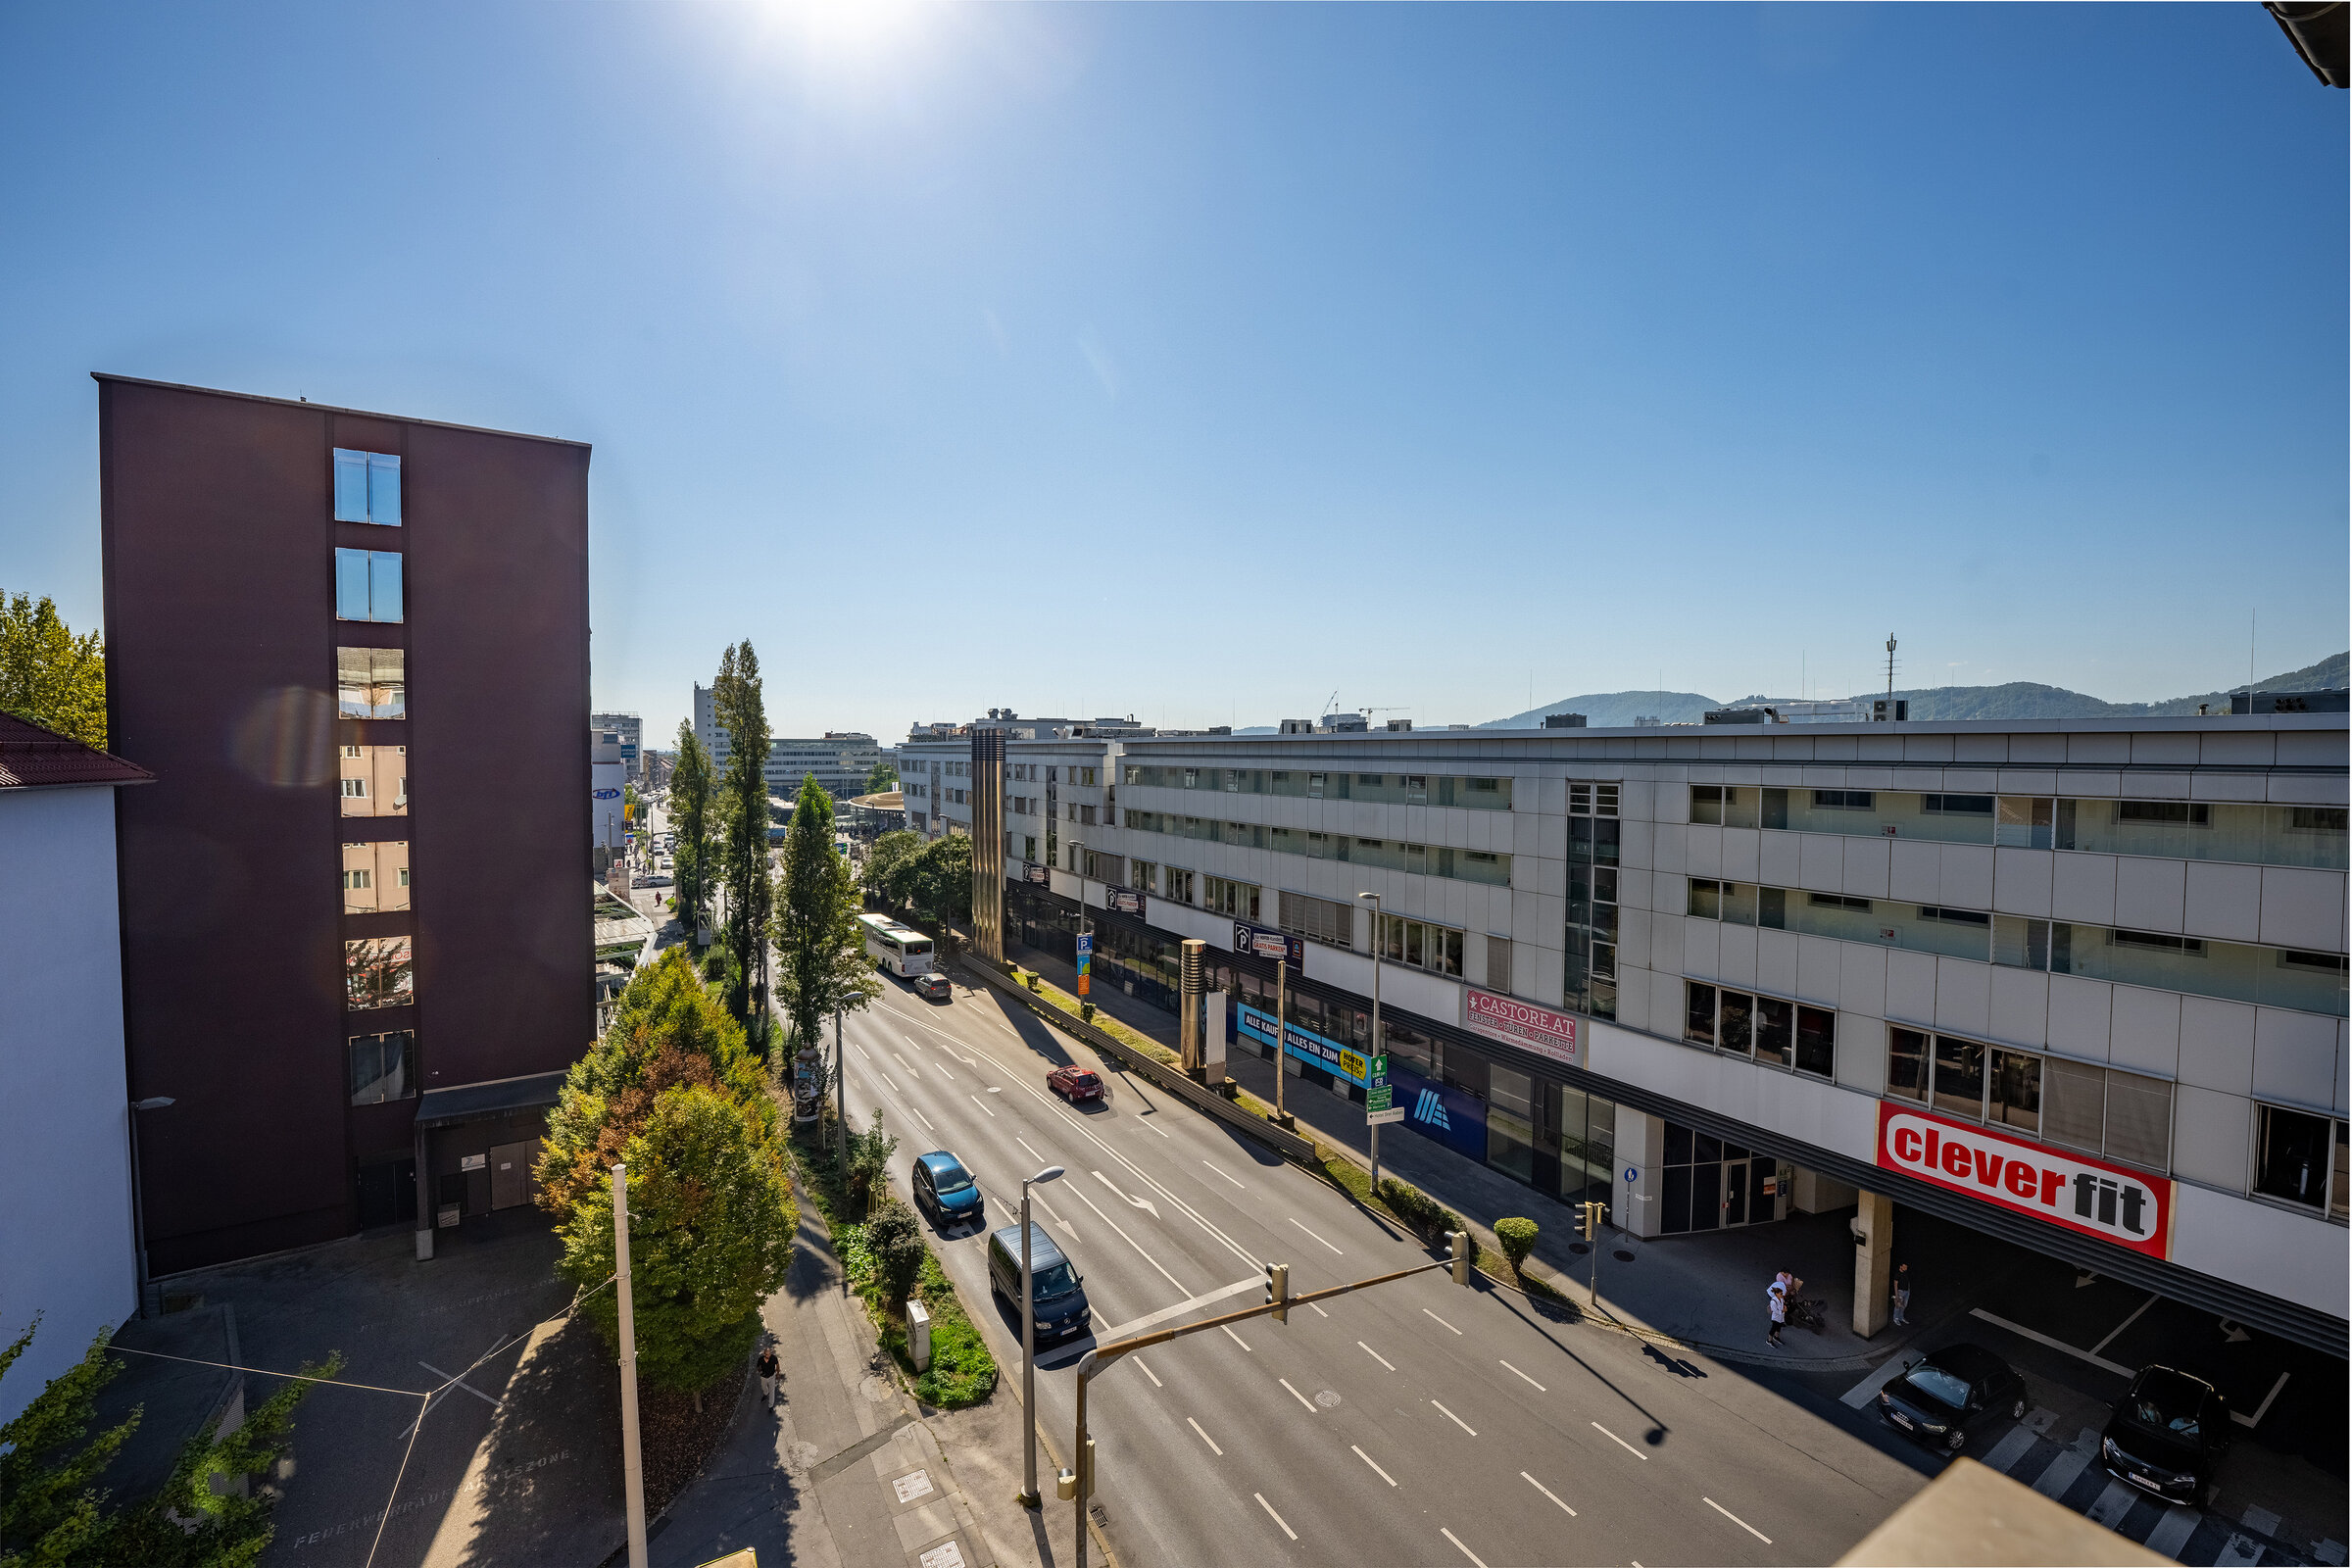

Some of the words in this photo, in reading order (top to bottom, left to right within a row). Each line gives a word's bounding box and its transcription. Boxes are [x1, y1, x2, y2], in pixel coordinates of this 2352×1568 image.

[1109, 895, 1115, 906] P
[1080, 940, 1088, 950] P
[1240, 934, 1247, 949] P
[1253, 941, 1267, 950] GRATIS
[1480, 996, 1574, 1036] CASTORE.AT
[1246, 1014, 1260, 1029] ALLE
[1261, 1020, 1287, 1041] KAUF
[1287, 1033, 1308, 1050] ALLES
[1308, 1041, 1321, 1055] EIN
[1322, 1047, 1339, 1063] ZUM
[1469, 1010, 1498, 1028] FENSTER
[1503, 1020, 1528, 1038] TÜREN
[1534, 1030, 1573, 1052] PARKETTE
[1343, 1052, 1363, 1068] HOFER
[1894, 1127, 2066, 1207] clever
[2073, 1172, 2146, 1236] fit
